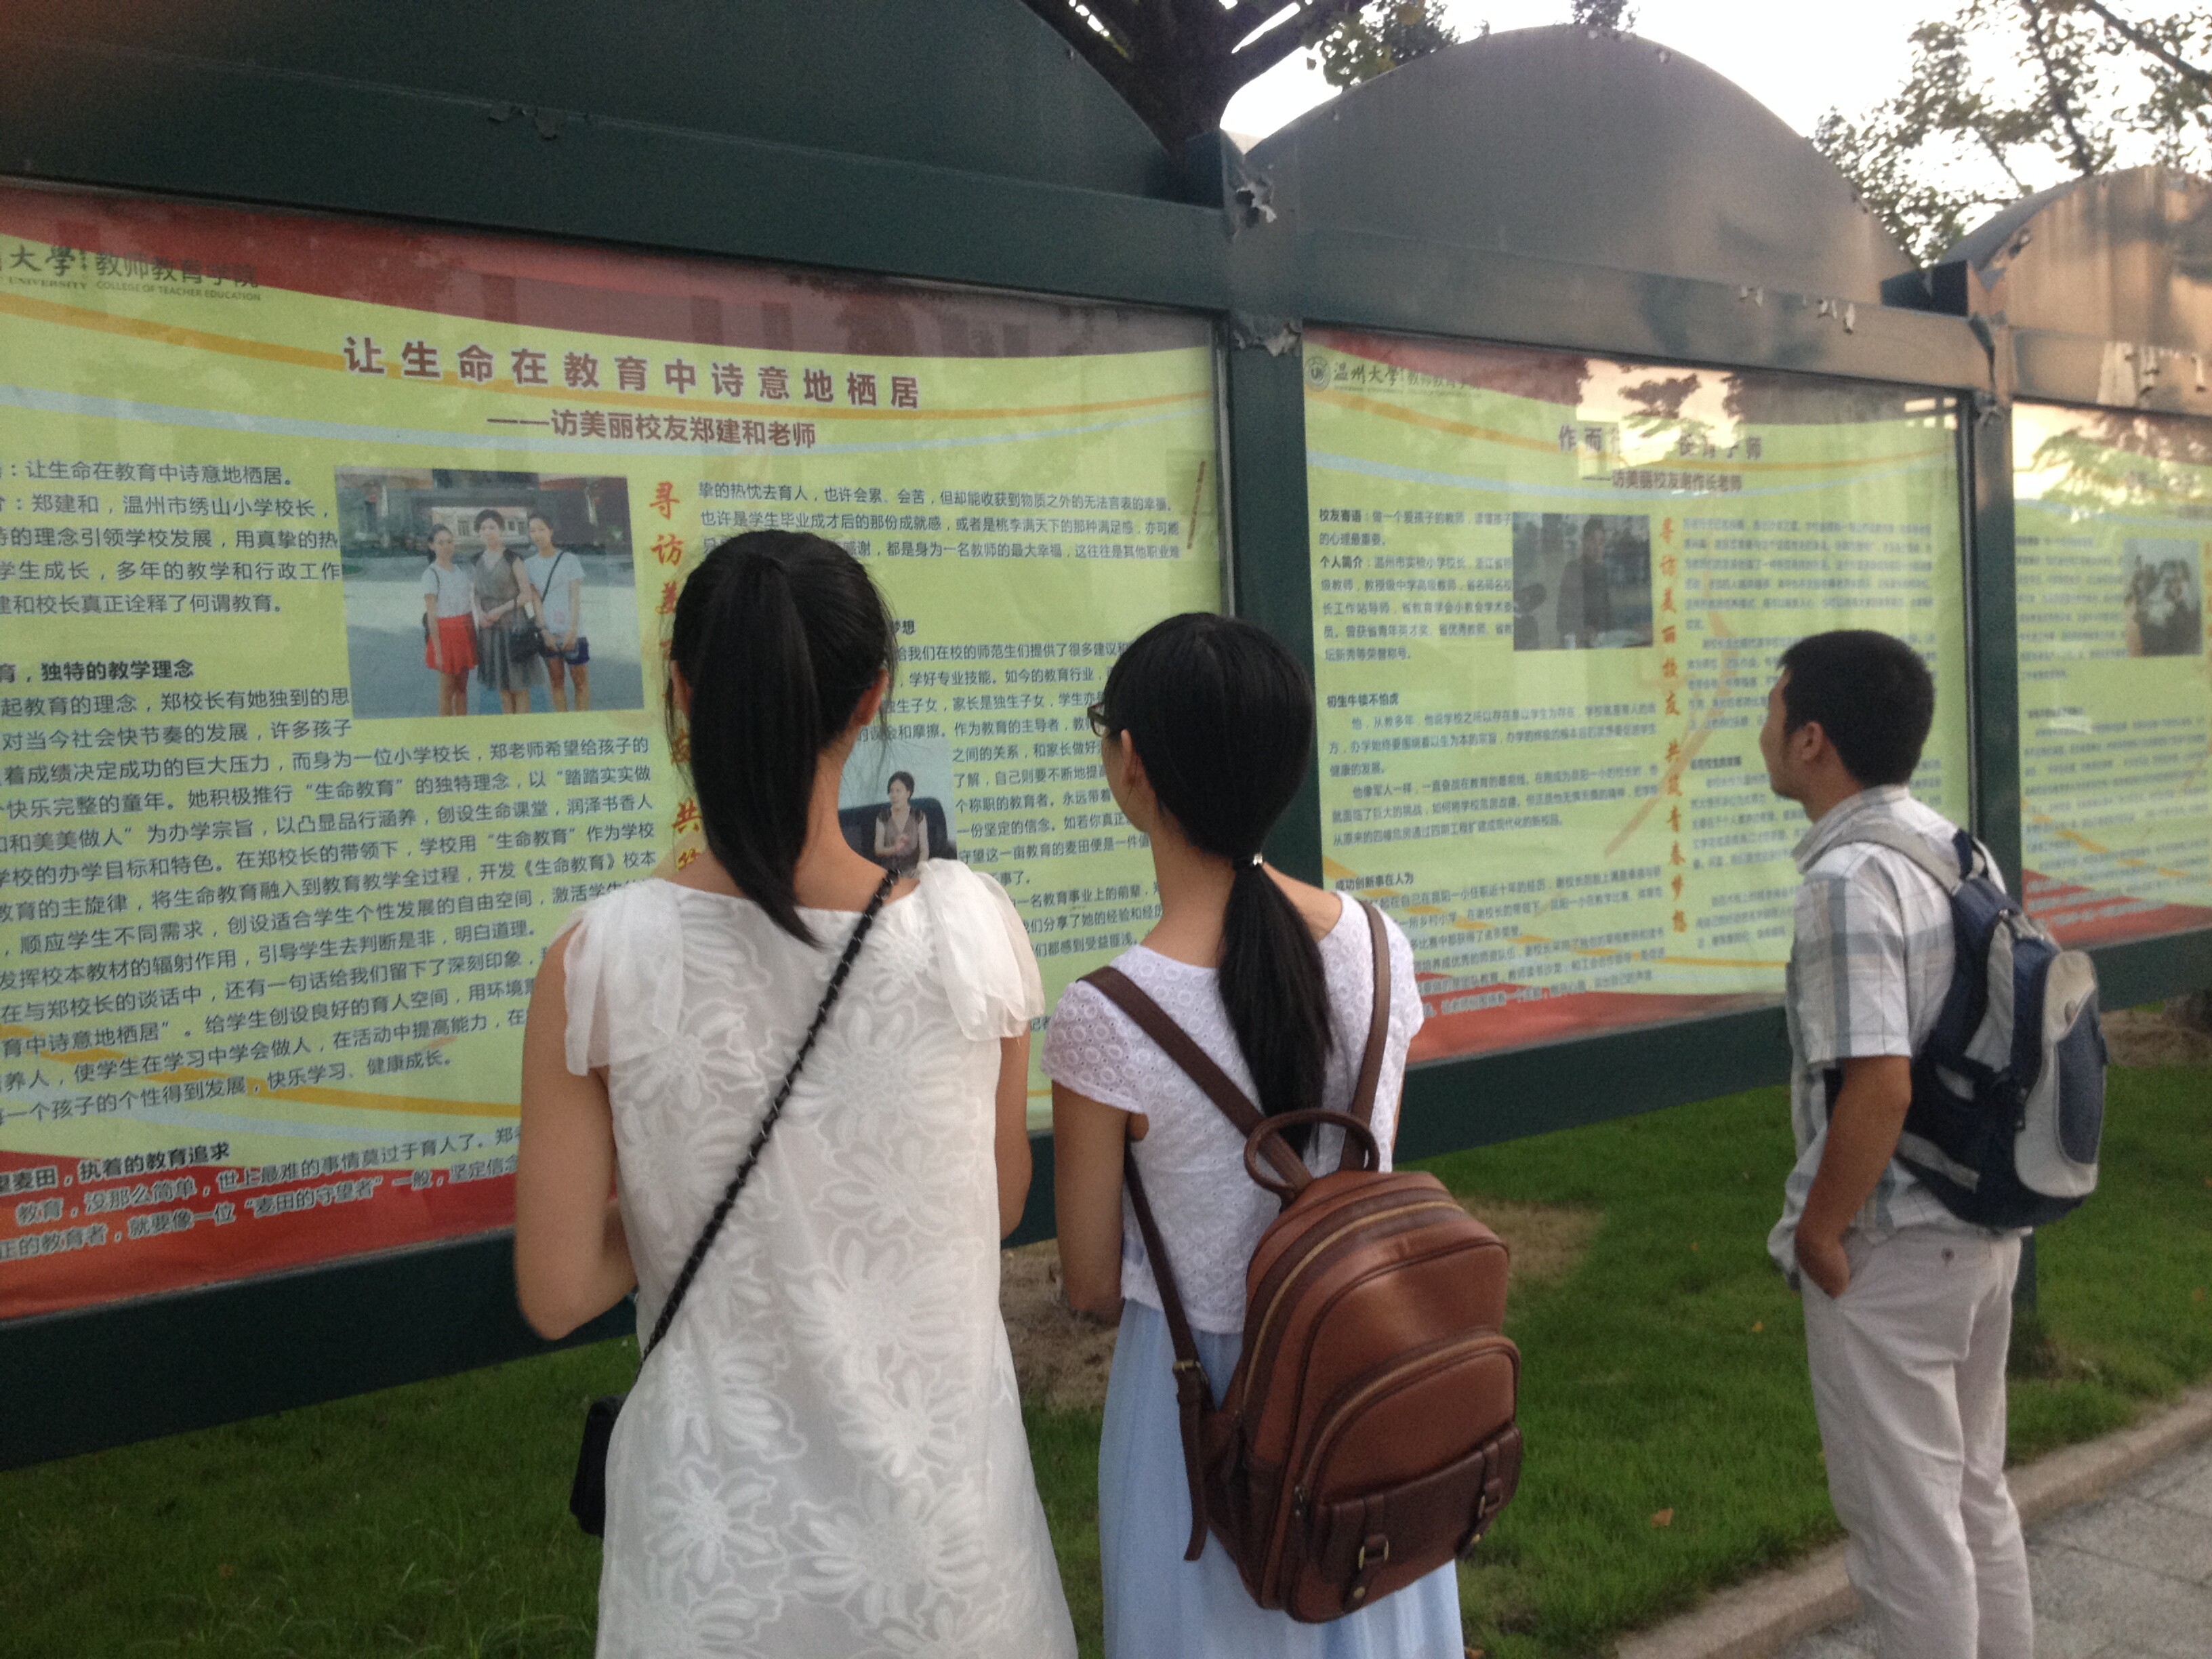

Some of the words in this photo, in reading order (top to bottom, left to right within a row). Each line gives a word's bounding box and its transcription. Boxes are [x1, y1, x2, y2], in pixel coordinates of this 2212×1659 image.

[96, 280, 140, 292] COLLEGE
[142, 283, 155, 293] OF
[158, 285, 202, 297] TEACHER
[204, 288, 261, 302] EDUCATION
[344, 336, 919, 409] 让生命在教育中诗意地栖居
[0, 459, 293, 486] :让生命在教育中诗意地栖居。
[0, 593, 283, 615] 和校长真正诠释了何谓教育。
[953, 739, 1102, 763] 之间的关系,和家长做好
[957, 811, 1130, 838] 一份坚定的信念。如若你真正
[1, 946, 548, 1024] 在与郑校长的谈话中,还有一句话给我们留下了深刻印象,
[0, 1008, 525, 1092] 养人,使学生在学习中学会做人,在活动中提高能力,在
[0, 1049, 452, 1126] 一个孩子的个性得到发展,快乐学习、健康成长。
